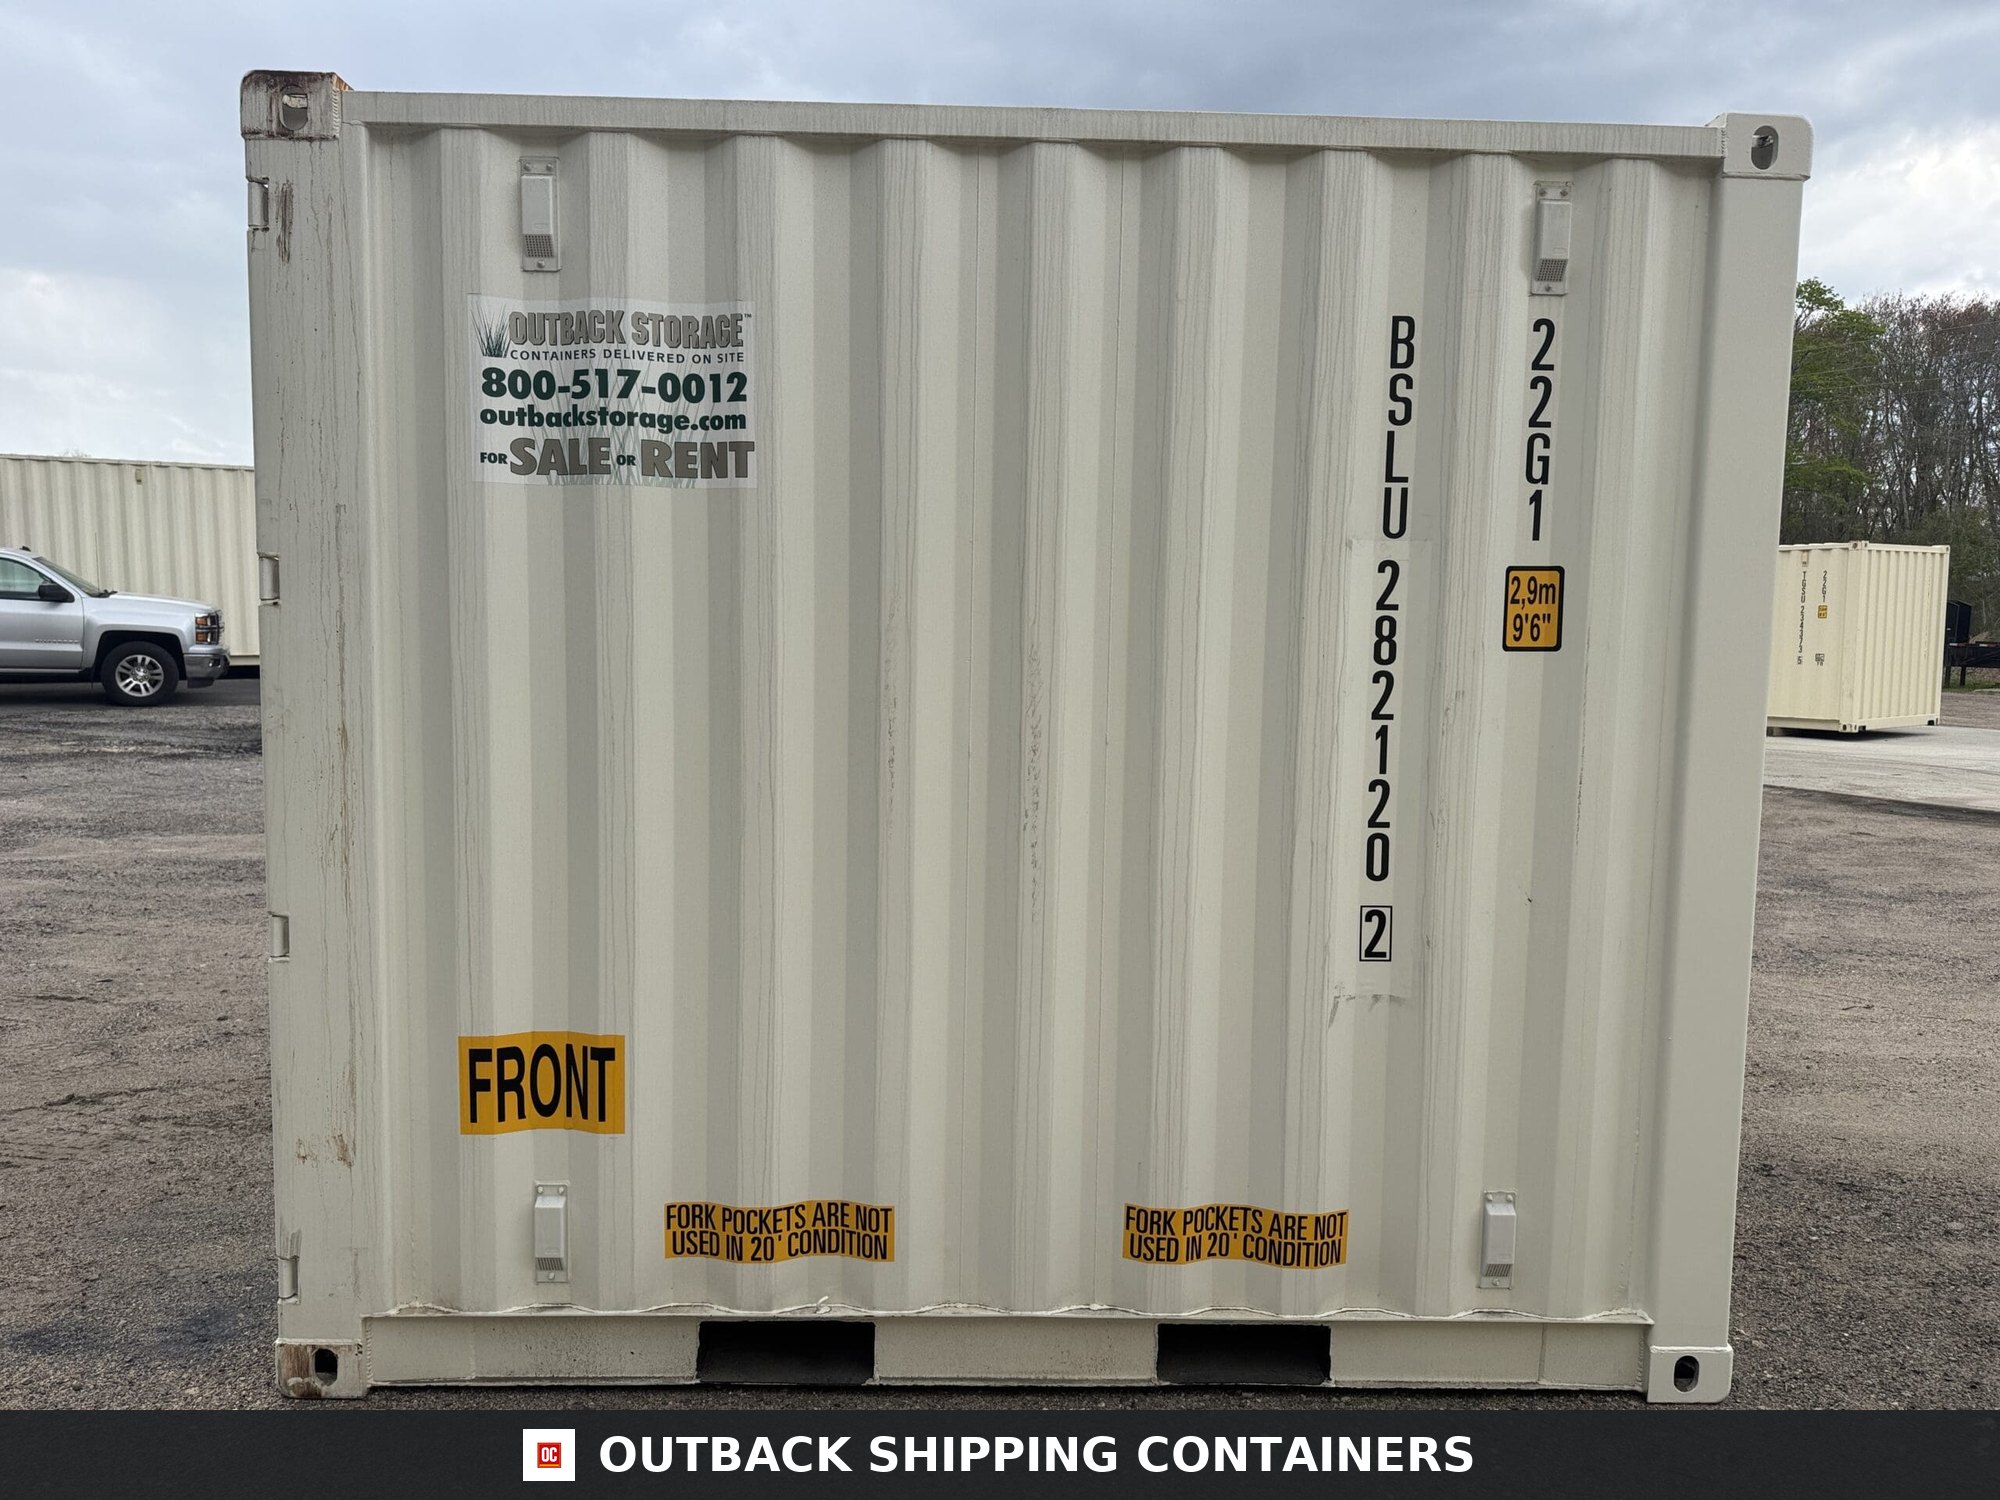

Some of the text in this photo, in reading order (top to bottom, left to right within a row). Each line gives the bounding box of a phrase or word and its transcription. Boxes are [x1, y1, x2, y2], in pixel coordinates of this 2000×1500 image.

[508, 310, 626, 346] OUTBACK
[510, 348, 745, 364] CONTAINERS DELIVERED ON SITE
[481, 367, 748, 403] 800-517-0012
[480, 404, 747, 434] outbackstorage.com
[1525, 318, 1556, 541] 22G1
[480, 437, 755, 479] FOR SALE OR RENT
[1510, 575, 1556, 610] 2,9m
[1363, 316, 1415, 959] BSLU 282120 2
[468, 1043, 616, 1124] FRONT
[666, 1202, 892, 1234] FORK POCKETS ARE NOT
[1126, 1205, 1347, 1240] FORK POCKETS ARE NOT
[672, 1230, 720, 1256] USED
[726, 1234, 743, 1261] IN
[787, 1229, 887, 1260] CONDITION
[1130, 1233, 1179, 1262] USED
[1186, 1234, 1202, 1261] IN
[1242, 1234, 1341, 1267] CONDITION
